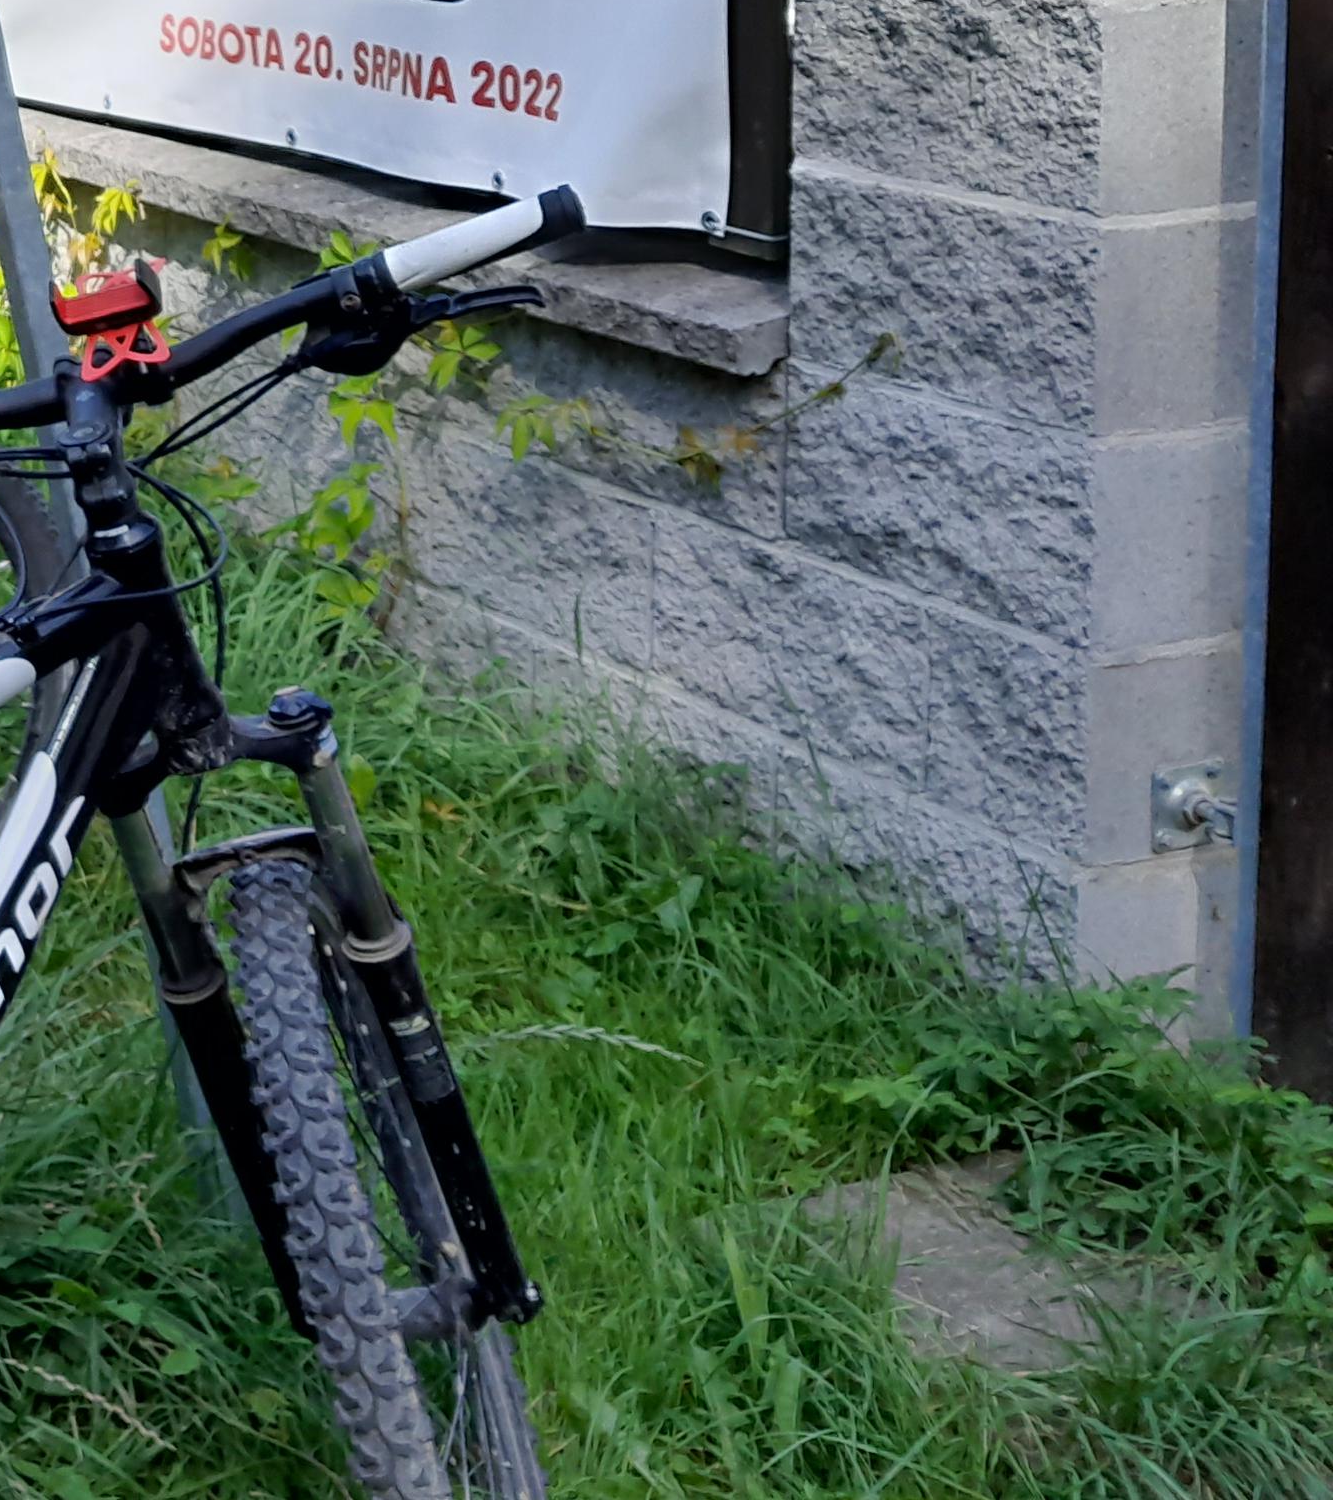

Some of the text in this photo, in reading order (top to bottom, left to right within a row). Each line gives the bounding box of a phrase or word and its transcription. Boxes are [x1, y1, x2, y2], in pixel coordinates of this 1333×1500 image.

[160, 13, 563, 122] SOBOTA 20. SRPNA 2022
